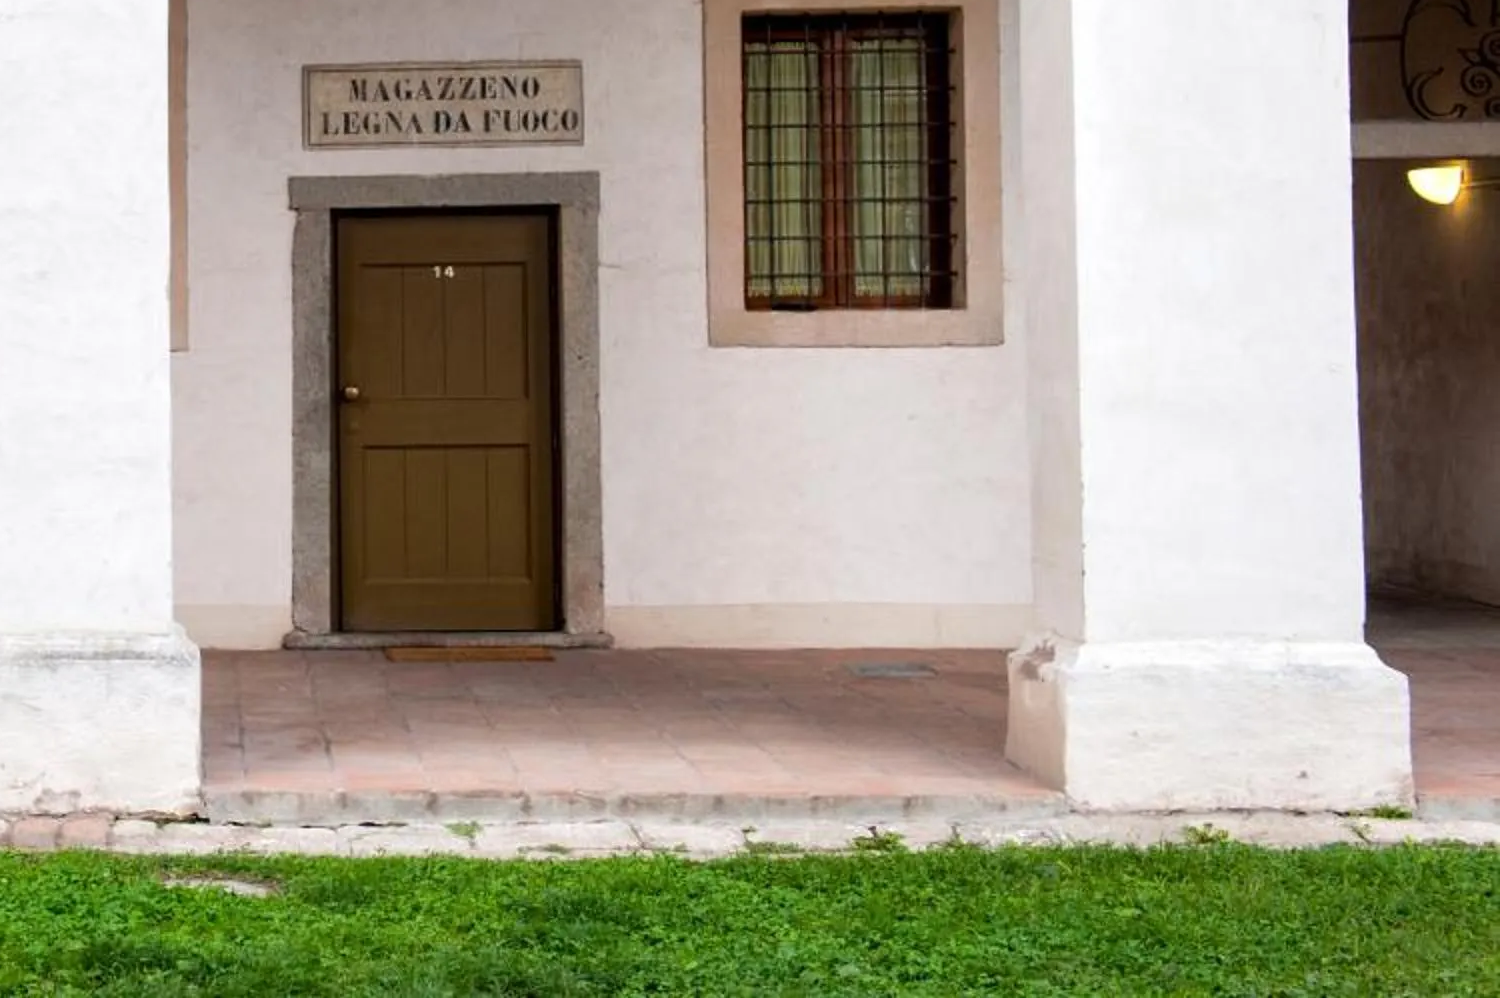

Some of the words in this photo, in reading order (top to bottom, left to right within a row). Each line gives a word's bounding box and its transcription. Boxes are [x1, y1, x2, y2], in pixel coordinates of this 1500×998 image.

[348, 76, 541, 102] MAGAZZENO
[321, 110, 424, 136] LEGNA
[432, 109, 472, 134] DA
[482, 108, 580, 133] FUOCO
[433, 265, 455, 279] 14
